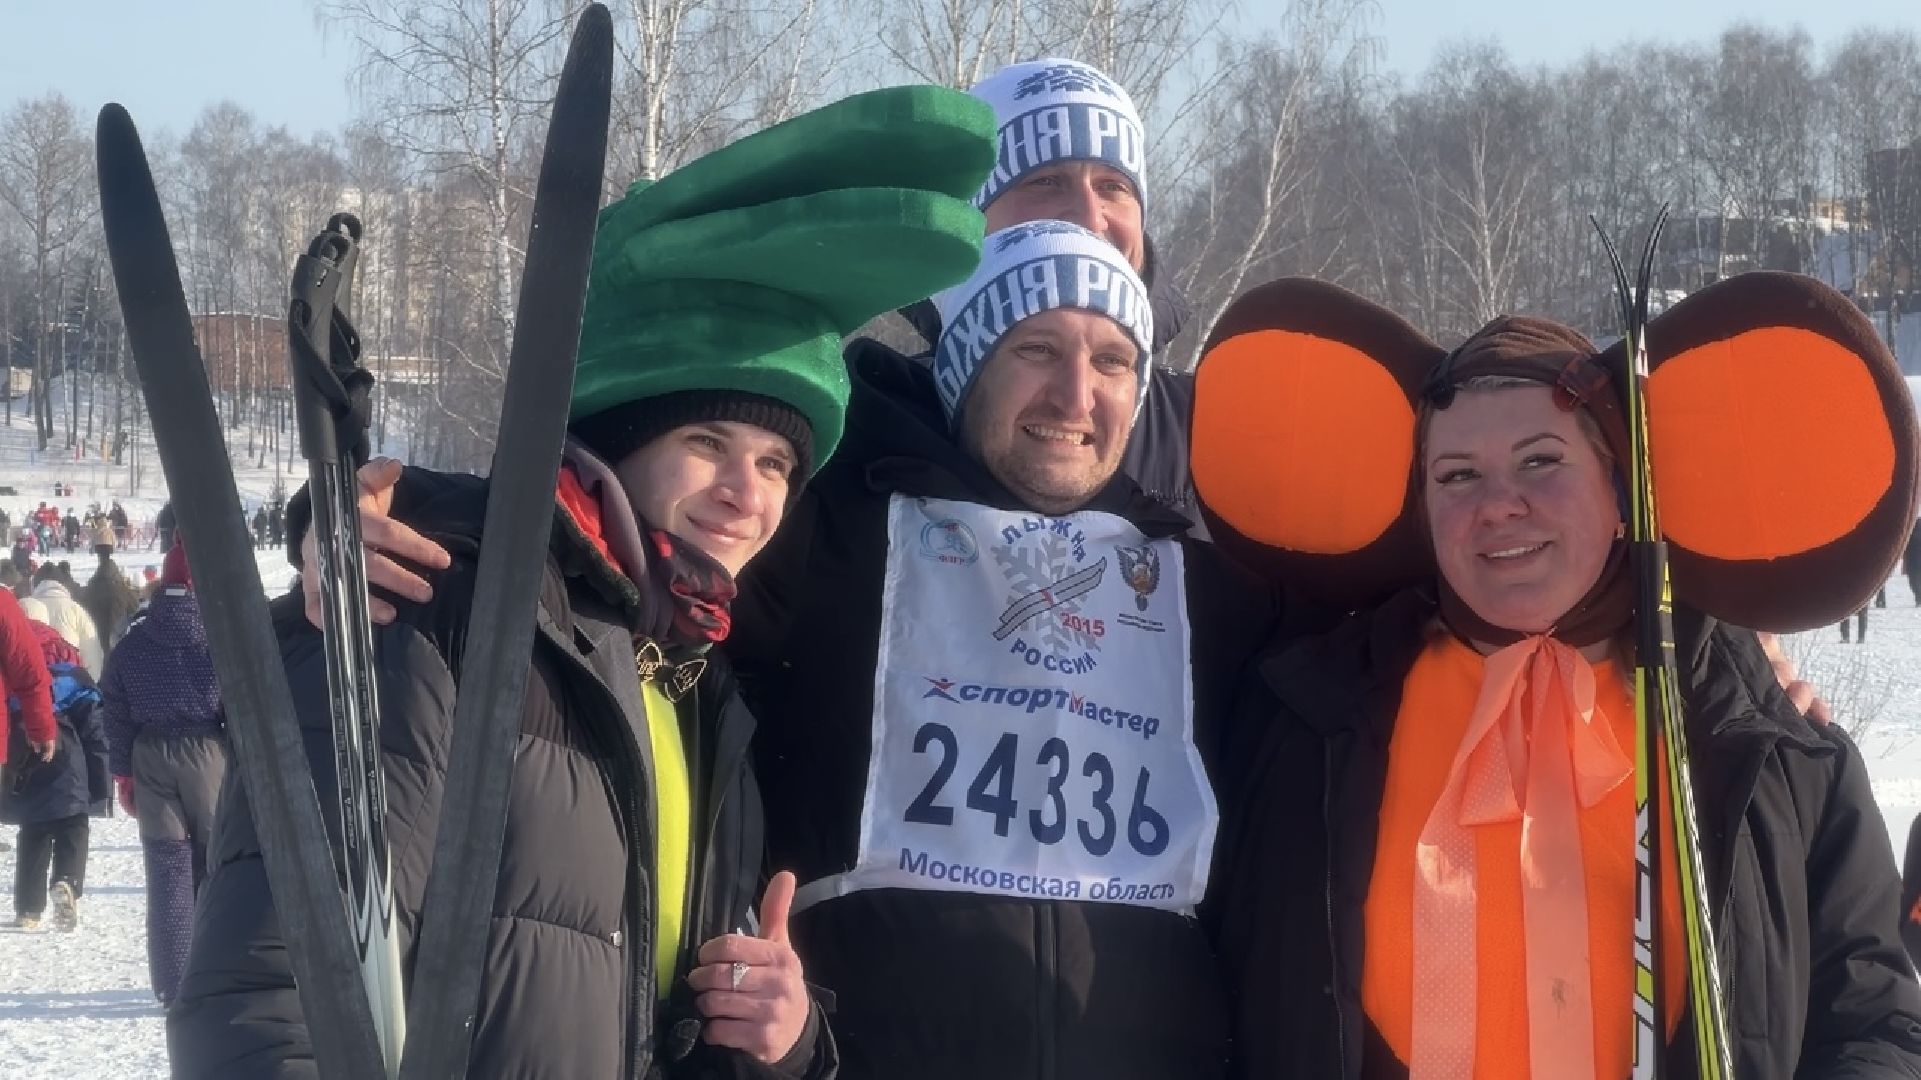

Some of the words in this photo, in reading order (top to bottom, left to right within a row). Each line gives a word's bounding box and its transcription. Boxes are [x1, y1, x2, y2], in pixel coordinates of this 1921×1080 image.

[1088, 106, 1143, 173] РО
[935, 259, 1060, 420] ЫЖНЯ
[1001, 517, 1087, 563] ЛЫЖНЯ
[1060, 612, 1105, 638] 2015
[1010, 637, 1098, 675] РОССИИ
[903, 722, 1170, 857] 24336
[899, 847, 1081, 899] Московская
[1088, 877, 1175, 901] область
